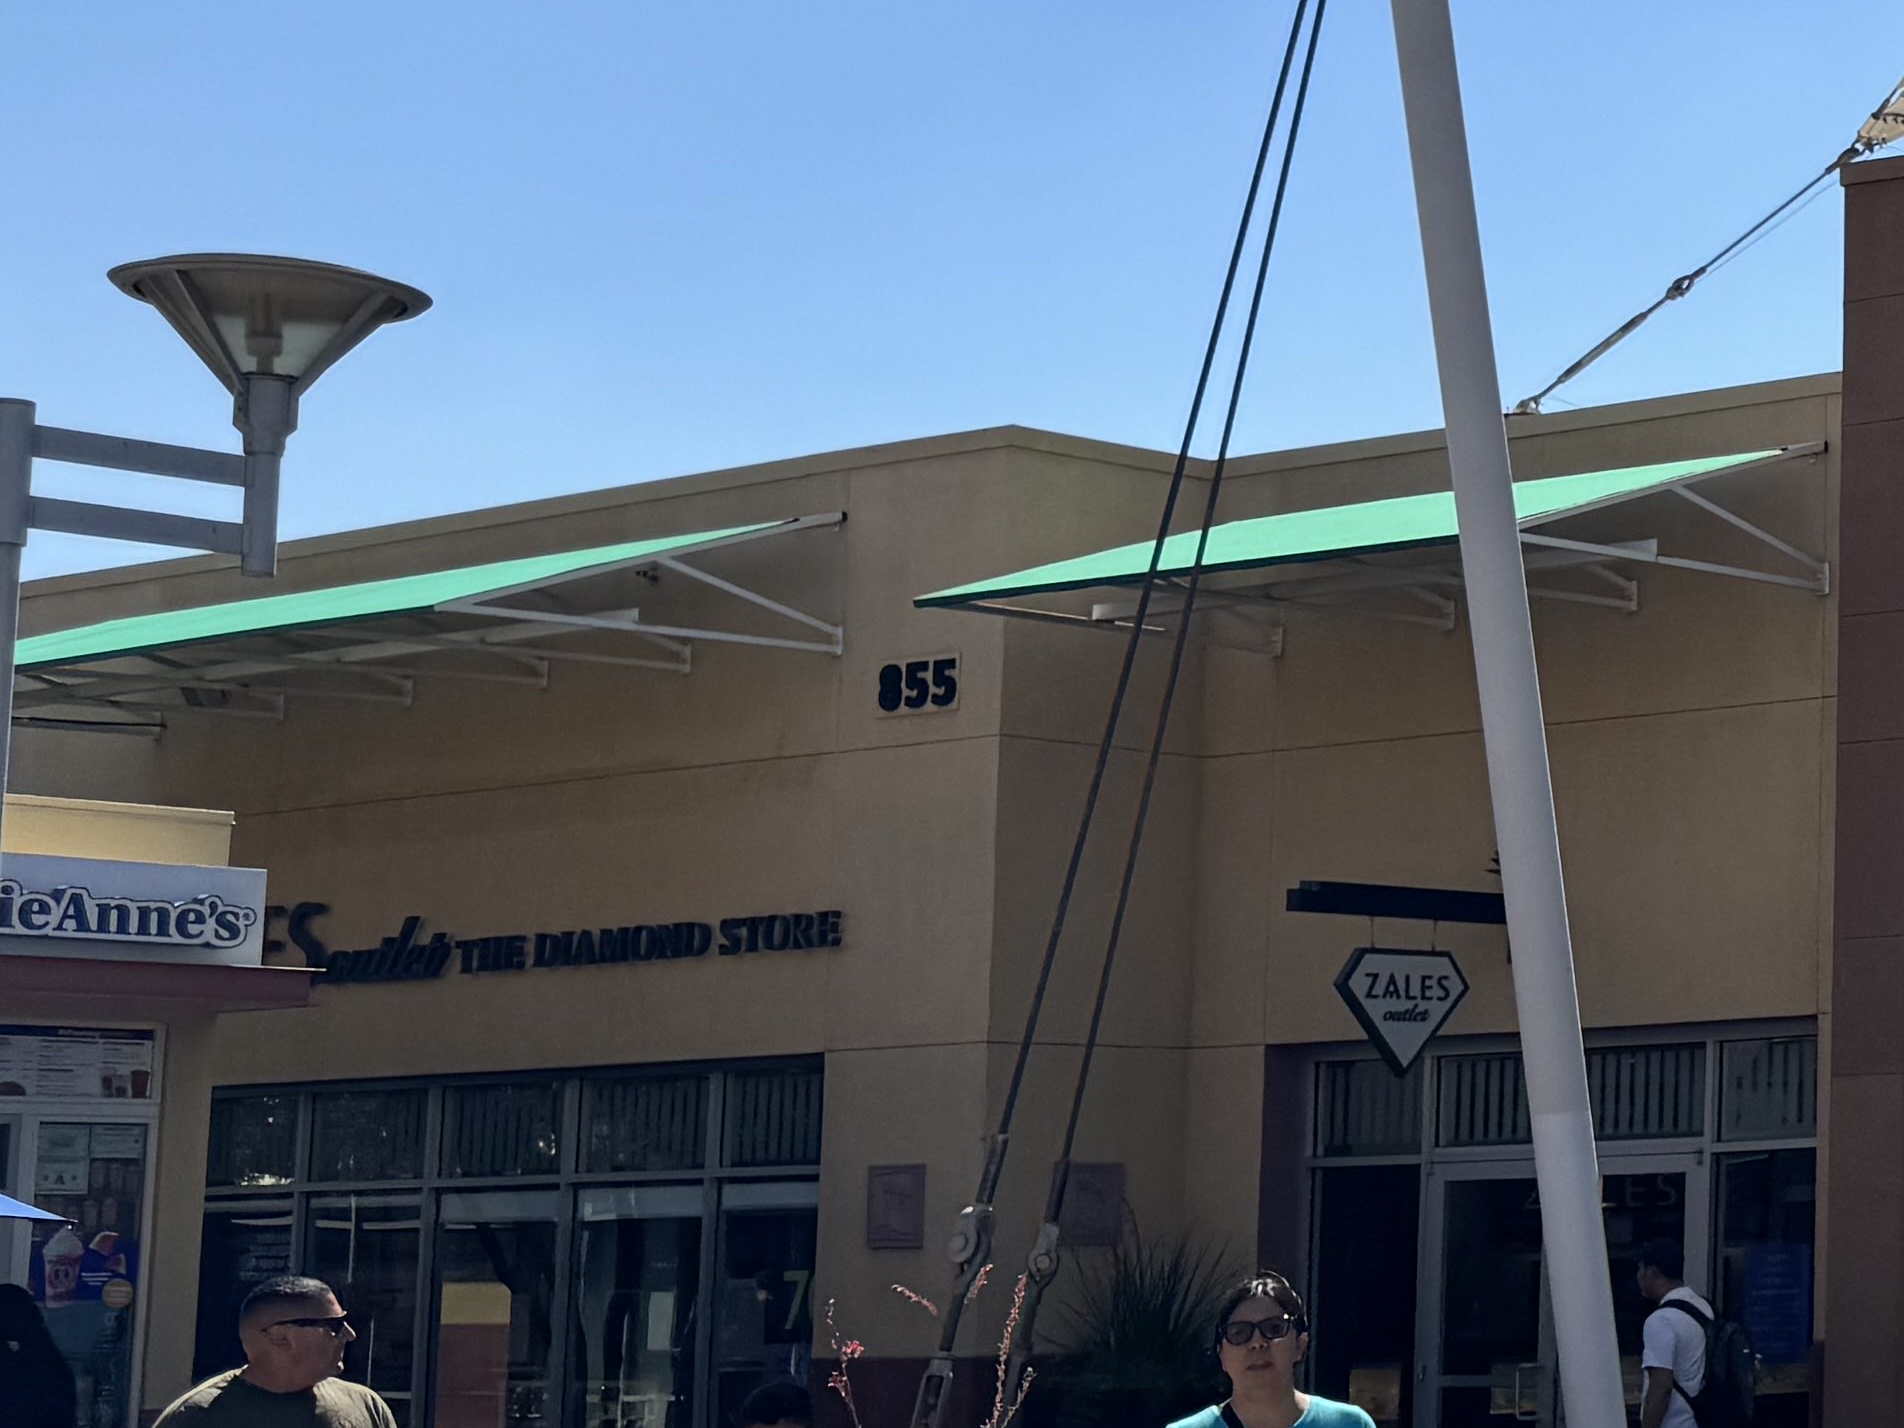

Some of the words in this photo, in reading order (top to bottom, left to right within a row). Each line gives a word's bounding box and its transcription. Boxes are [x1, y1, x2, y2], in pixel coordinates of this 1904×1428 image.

[879, 659, 957, 711] 855
[455, 935, 527, 973] THE
[533, 922, 712, 968] DIAMOND
[718, 910, 842, 956] STORE
[1364, 972, 1450, 1001] ZALES
[1382, 1003, 1431, 1022] outlet
